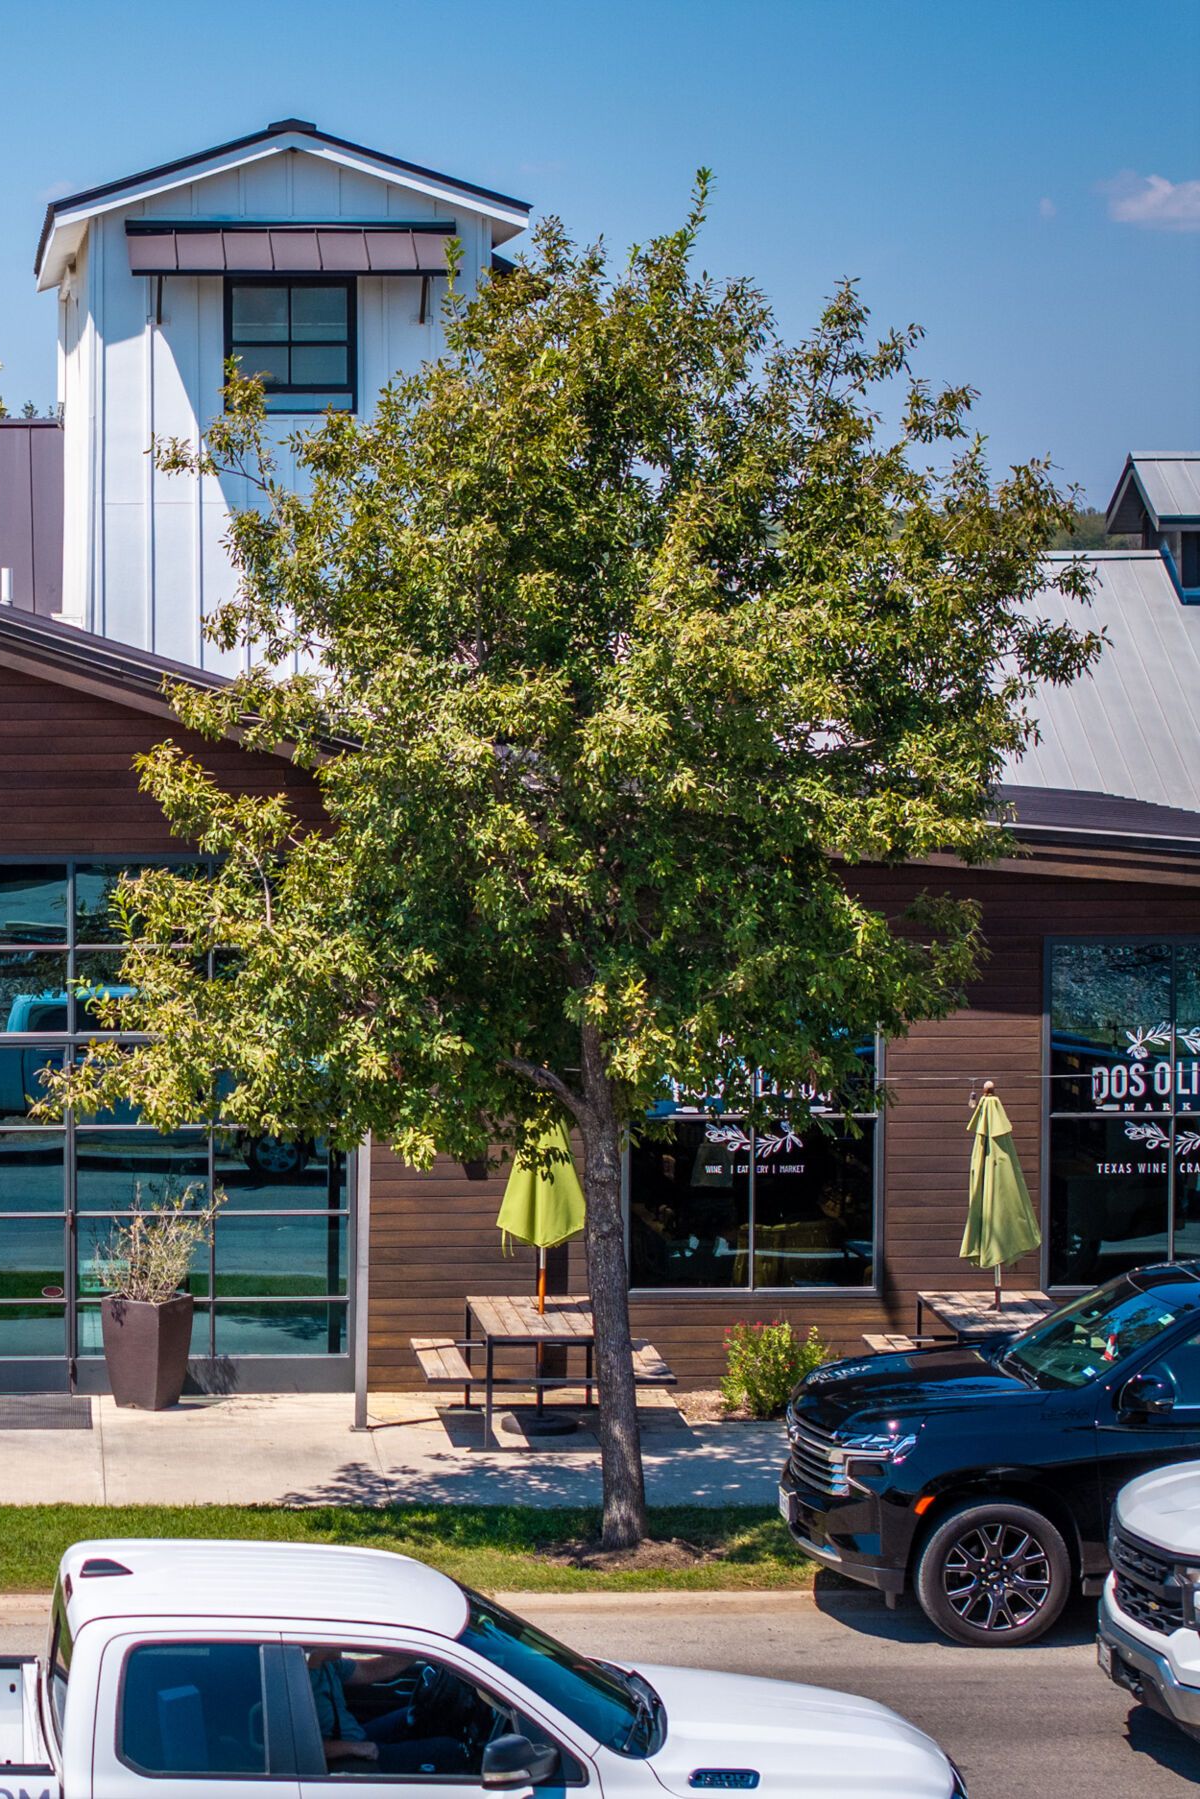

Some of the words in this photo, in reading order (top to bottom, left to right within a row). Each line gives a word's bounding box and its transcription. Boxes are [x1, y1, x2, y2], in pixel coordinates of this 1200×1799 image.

[1091, 1063, 1146, 1100] DOS
[704, 1164, 723, 1174] WINE
[779, 1164, 805, 1174] MARKET
[1096, 1163, 1133, 1174] TEXAS
[1137, 1162, 1168, 1174] WINE
